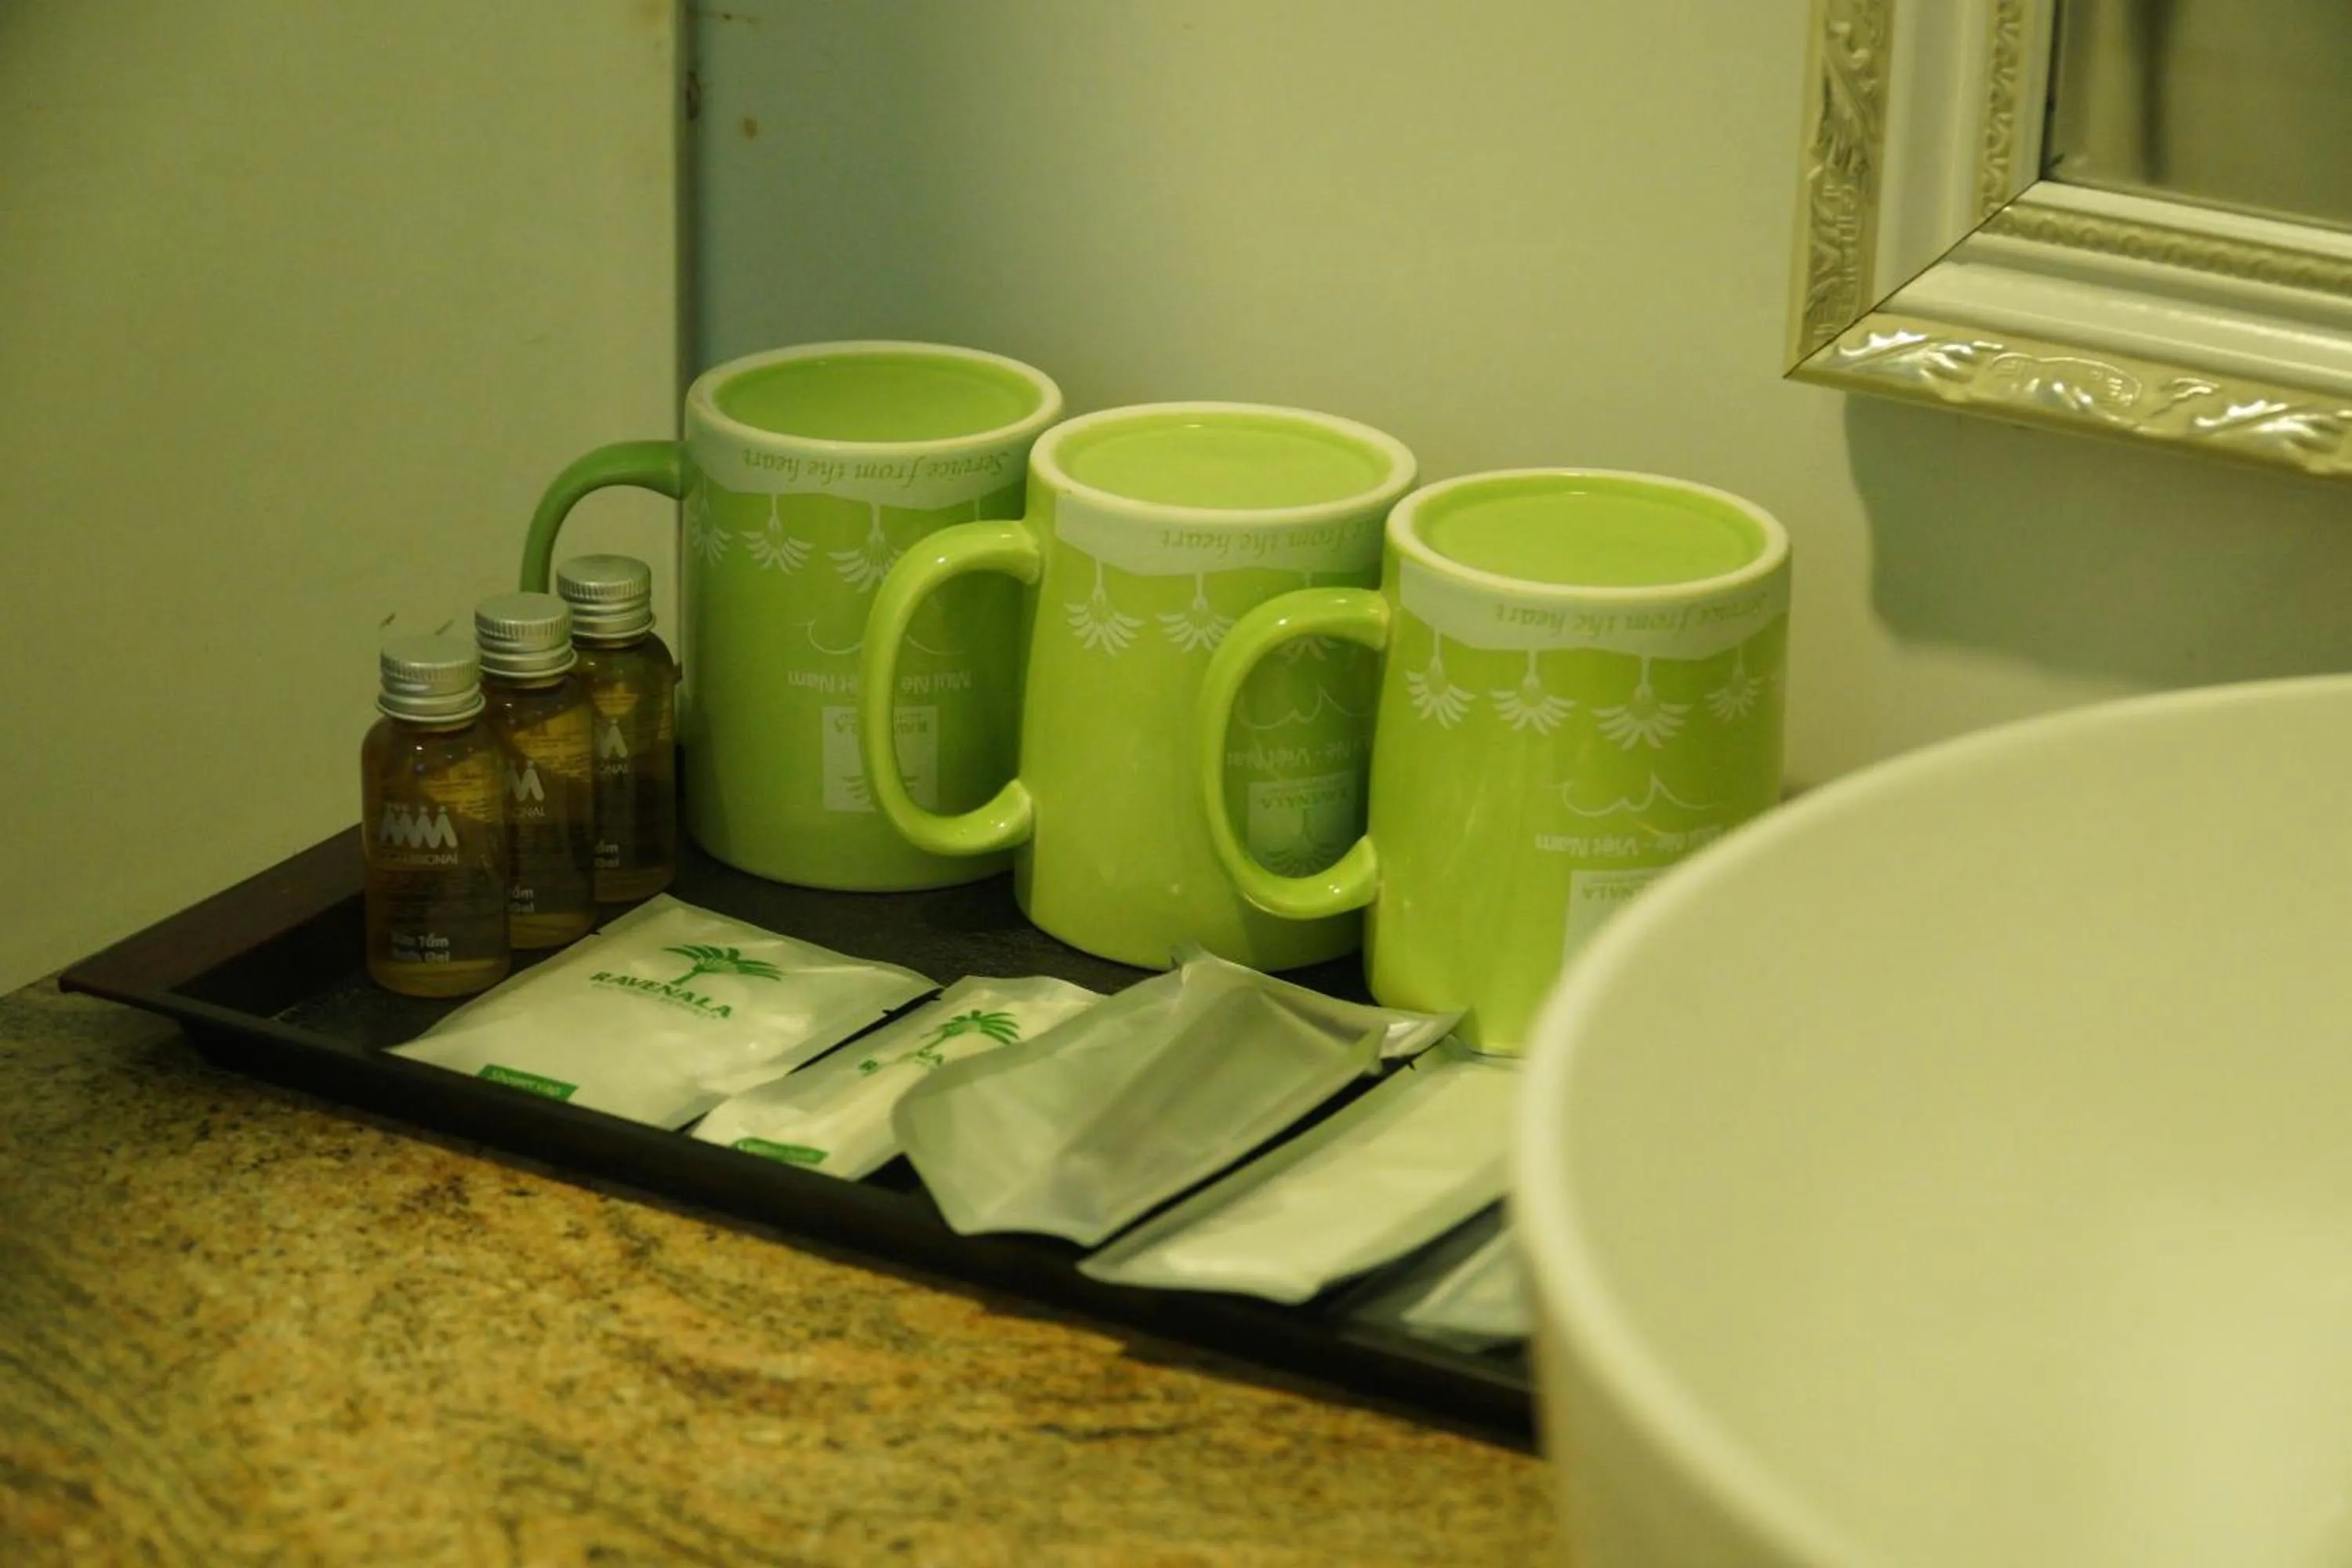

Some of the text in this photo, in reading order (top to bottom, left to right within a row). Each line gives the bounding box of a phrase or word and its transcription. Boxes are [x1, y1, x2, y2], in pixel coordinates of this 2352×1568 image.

[741, 448, 801, 484] heart
[808, 460, 846, 487] the
[854, 456, 927, 491] from
[1160, 529, 1232, 561] heart
[1238, 533, 1279, 561] the
[1495, 602, 1567, 639] heart
[1573, 614, 1617, 642] the
[1624, 604, 1698, 641] from
[787, 670, 836, 695] Nam
[1534, 833, 1589, 859] Nam
[590, 970, 733, 1018] RAVENALA
